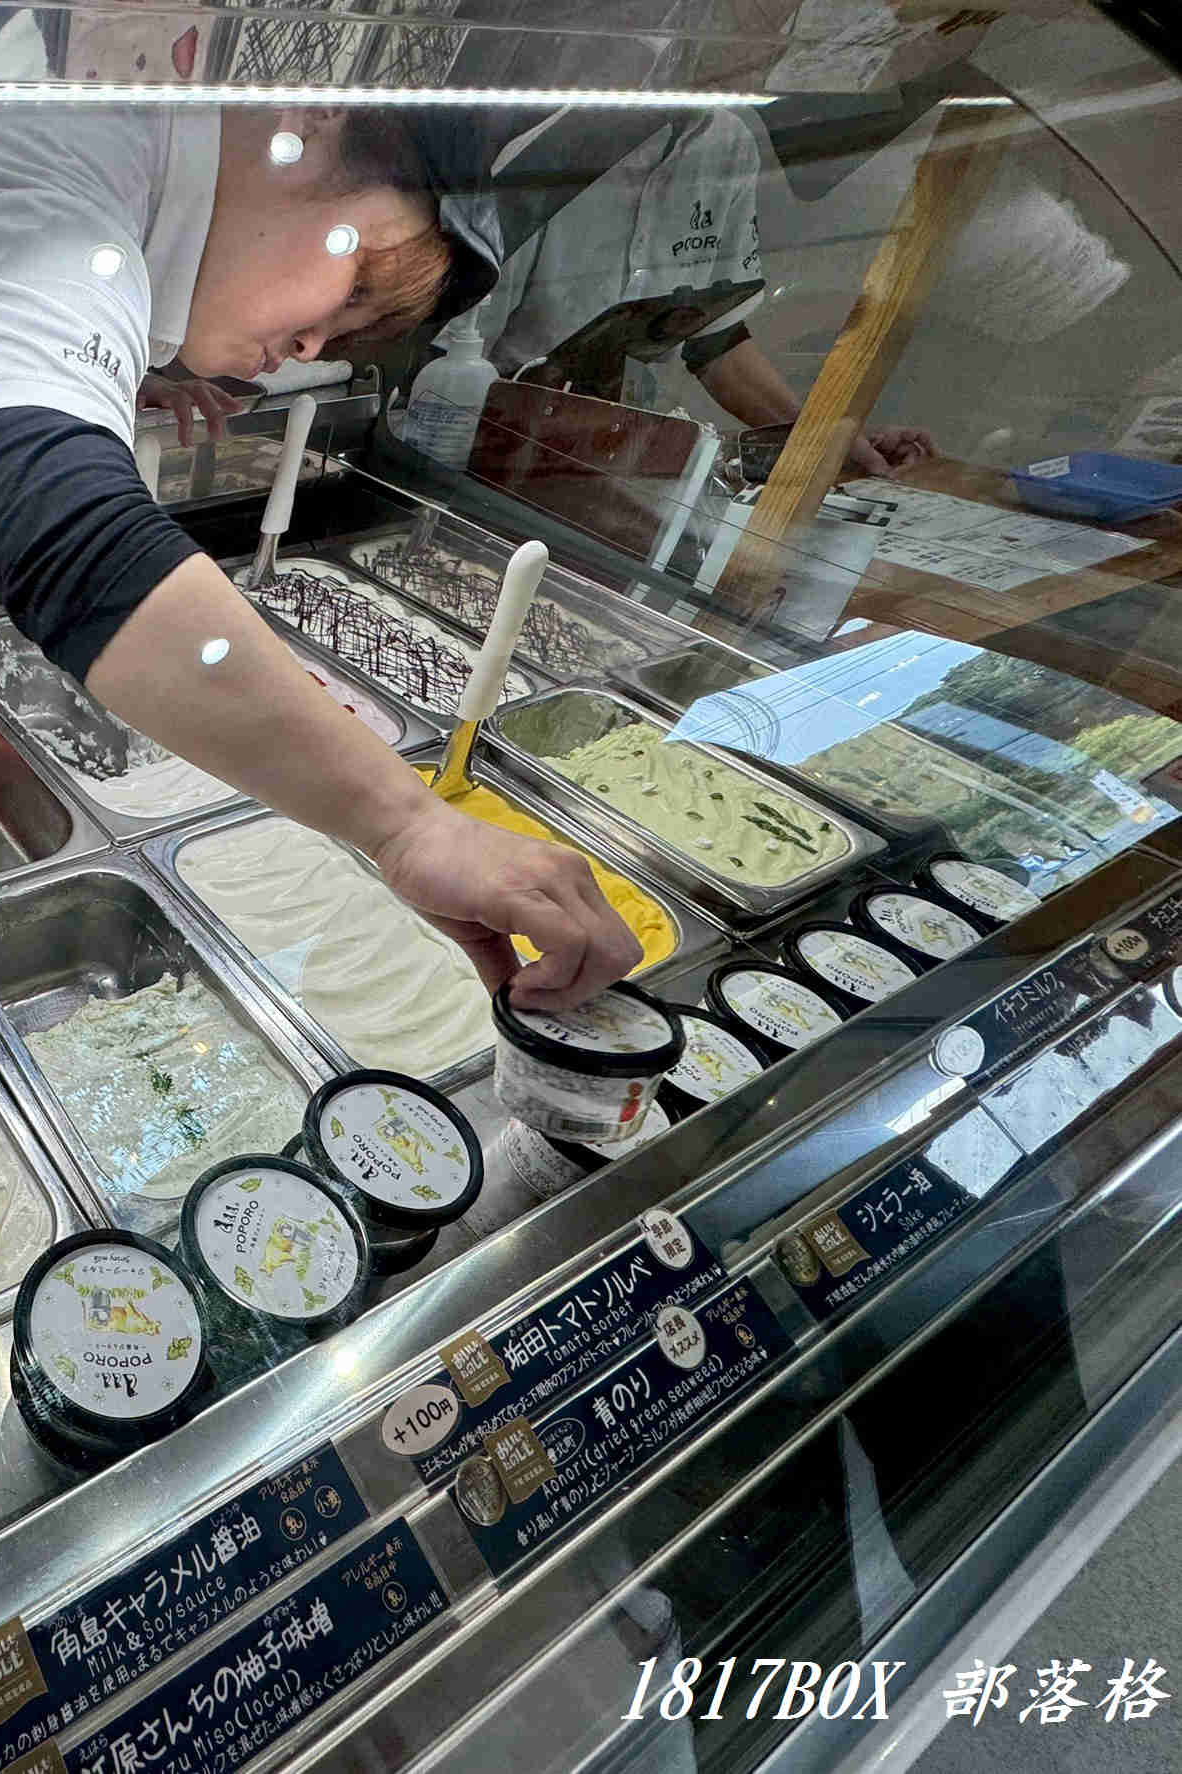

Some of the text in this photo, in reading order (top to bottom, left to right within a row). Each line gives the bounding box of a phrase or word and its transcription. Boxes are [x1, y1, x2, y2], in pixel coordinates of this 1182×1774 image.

[352, 1134, 402, 1181] POPORO
[235, 1200, 259, 1253] POPORO
[544, 1301, 635, 1367] Tomato sorbet
[662, 1314, 686, 1337] 店長
[83, 1351, 153, 1369] POPORO
[393, 1397, 454, 1444] +100円
[592, 1367, 651, 1430] 青のり
[629, 1399, 668, 1435] green
